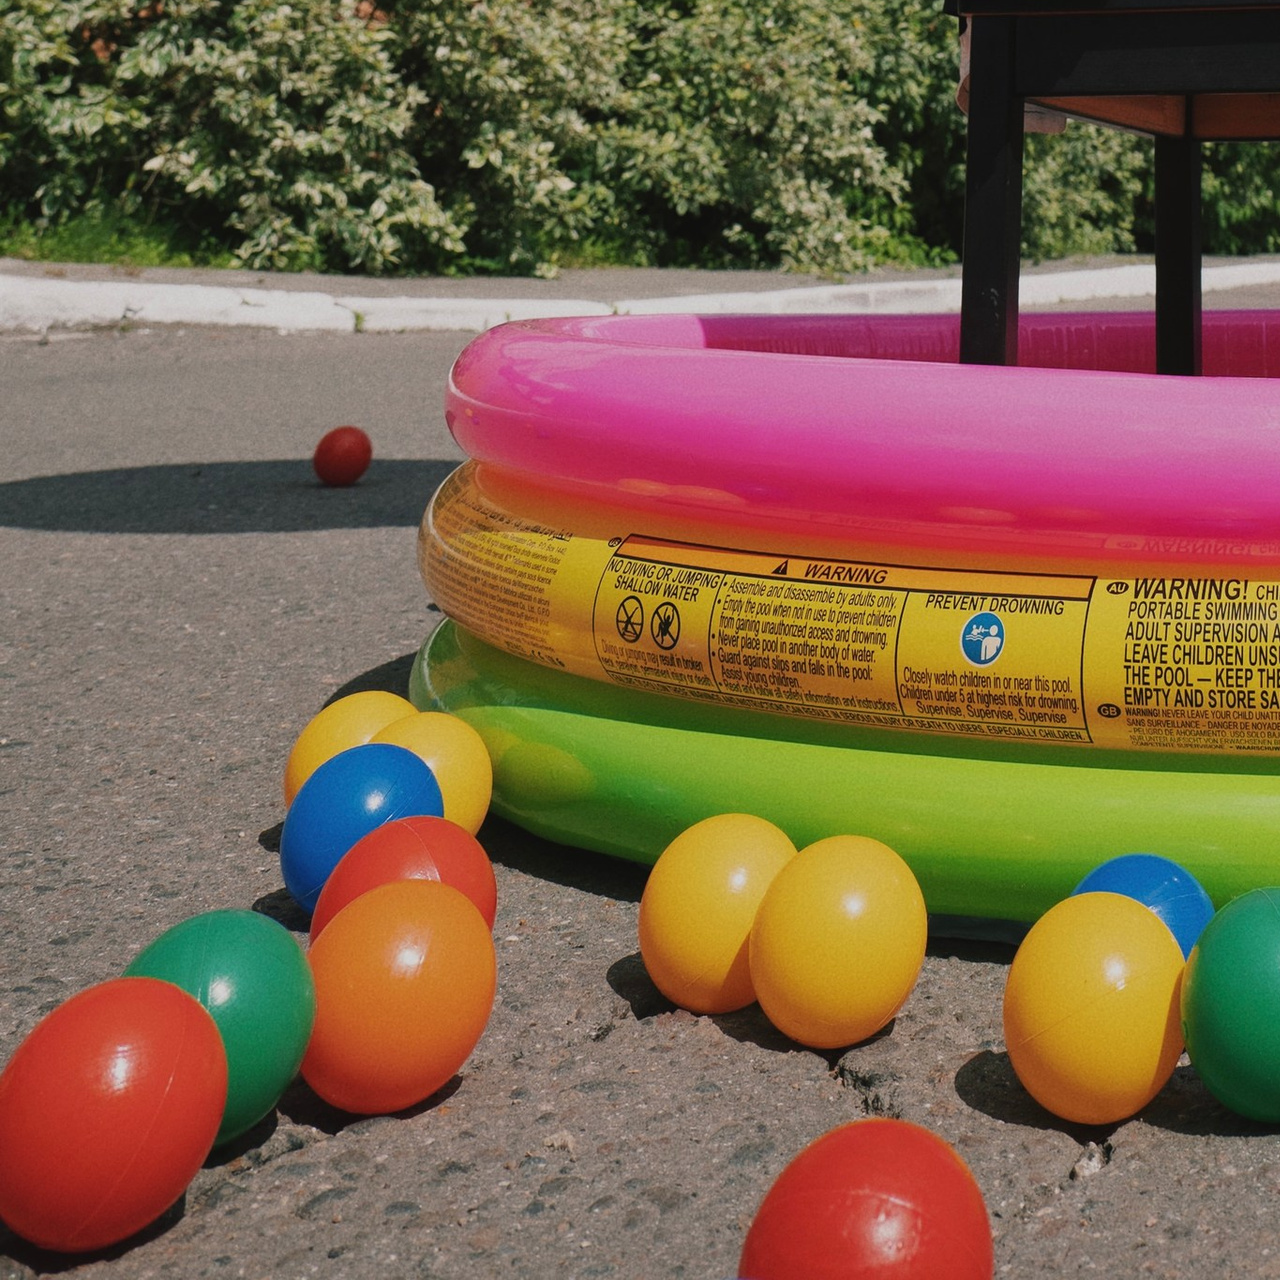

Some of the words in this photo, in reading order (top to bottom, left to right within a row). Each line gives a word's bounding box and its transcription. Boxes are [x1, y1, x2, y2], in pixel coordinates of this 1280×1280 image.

[608, 558, 624, 573] NO
[622, 561, 656, 579] DIVING
[656, 566, 673, 581] OR
[672, 569, 721, 589] JUMPING
[804, 563, 888, 584] WARNING
[614, 575, 662, 596] SHALLOW
[663, 584, 699, 602] WATER
[727, 577, 767, 596] Assemble
[766, 583, 783, 599] and
[783, 584, 835, 604] disassemble
[836, 588, 848, 609] by
[848, 592, 875, 608] adults
[877, 593, 897, 612] only.
[1133, 577, 1249, 600] WARNING!
[722, 594, 745, 616] Empty
[745, 598, 755, 612] the
[756, 600, 773, 619] pool
[772, 601, 792, 618] when
[792, 605, 805, 620] not
[804, 604, 813, 621] in
[813, 609, 827, 622] use
[828, 608, 835, 623] to
[836, 609, 866, 627] prevent
[866, 609, 896, 628] children
[925, 594, 987, 611] PREVENT
[989, 597, 1065, 615] DROWNING
[1127, 600, 1202, 620] PORTABLE
[1205, 602, 1278, 621] SWIMMING
[720, 612, 735, 629] from
[735, 614, 761, 637] gaining
[761, 621, 807, 638] unauthorized
[807, 626, 834, 641] access
[835, 626, 850, 643] and
[851, 628, 888, 650] drowning.
[1125, 621, 1171, 641] ADULT
[1174, 622, 1268, 643] SUPERVISION
[718, 629, 739, 646] Never
[740, 633, 760, 653] place
[762, 636, 779, 656] pool
[779, 637, 787, 651] in
[788, 640, 818, 655] another
[820, 642, 840, 663] body
[841, 644, 850, 661] of
[851, 647, 876, 663] water.
[1124, 643, 1168, 664] LEAVE
[1172, 644, 1244, 666] CHILDREN
[717, 647, 741, 665] Guard
[742, 652, 770, 670] against
[771, 655, 790, 673] slips
[791, 657, 807, 673] and
[808, 659, 825, 676] falls
[827, 661, 835, 677] in
[836, 661, 850, 678] the
[852, 665, 873, 682] pool:
[1124, 665, 1150, 686] THE
[1155, 666, 1194, 687] POOL
[1215, 668, 1253, 688] KEEP
[721, 665, 744, 681] Assist
[743, 671, 768, 687] young
[768, 671, 802, 689] children.
[903, 666, 932, 688] Closely
[933, 669, 957, 686] watch
[959, 671, 992, 688] children
[993, 672, 1001, 688] in
[1003, 677, 1012, 689] or
[1013, 677, 1032, 690] near
[1035, 675, 1050, 692] this
[1051, 676, 1072, 693] pool.
[900, 683, 935, 700] Children
[935, 687, 957, 703] under
[959, 690, 965, 703] 5
[966, 691, 975, 704] at
[976, 690, 1007, 708] highest
[1008, 692, 1023, 706] risk
[1024, 692, 1036, 706] for
[1037, 693, 1079, 714] drowning.
[1124, 687, 1171, 707] EMPTY
[1174, 688, 1204, 708] AND
[1208, 689, 1256, 709] STORE
[915, 700, 966, 718] Supervise,
[966, 704, 1017, 722] Supervise,
[1018, 708, 1067, 724] Supervise
[1124, 707, 1160, 717] WARNING!
[1161, 709, 1186, 718] NEVER
[1187, 709, 1209, 719] LEAVE
[1211, 710, 1232, 720] YOUR
[1234, 711, 1254, 720] CHILD
[1126, 718, 1145, 727] SANS
[1147, 719, 1200, 729] SURVEILLANCE
[1207, 721, 1238, 730] DANGER
[1240, 721, 1250, 730] DE
